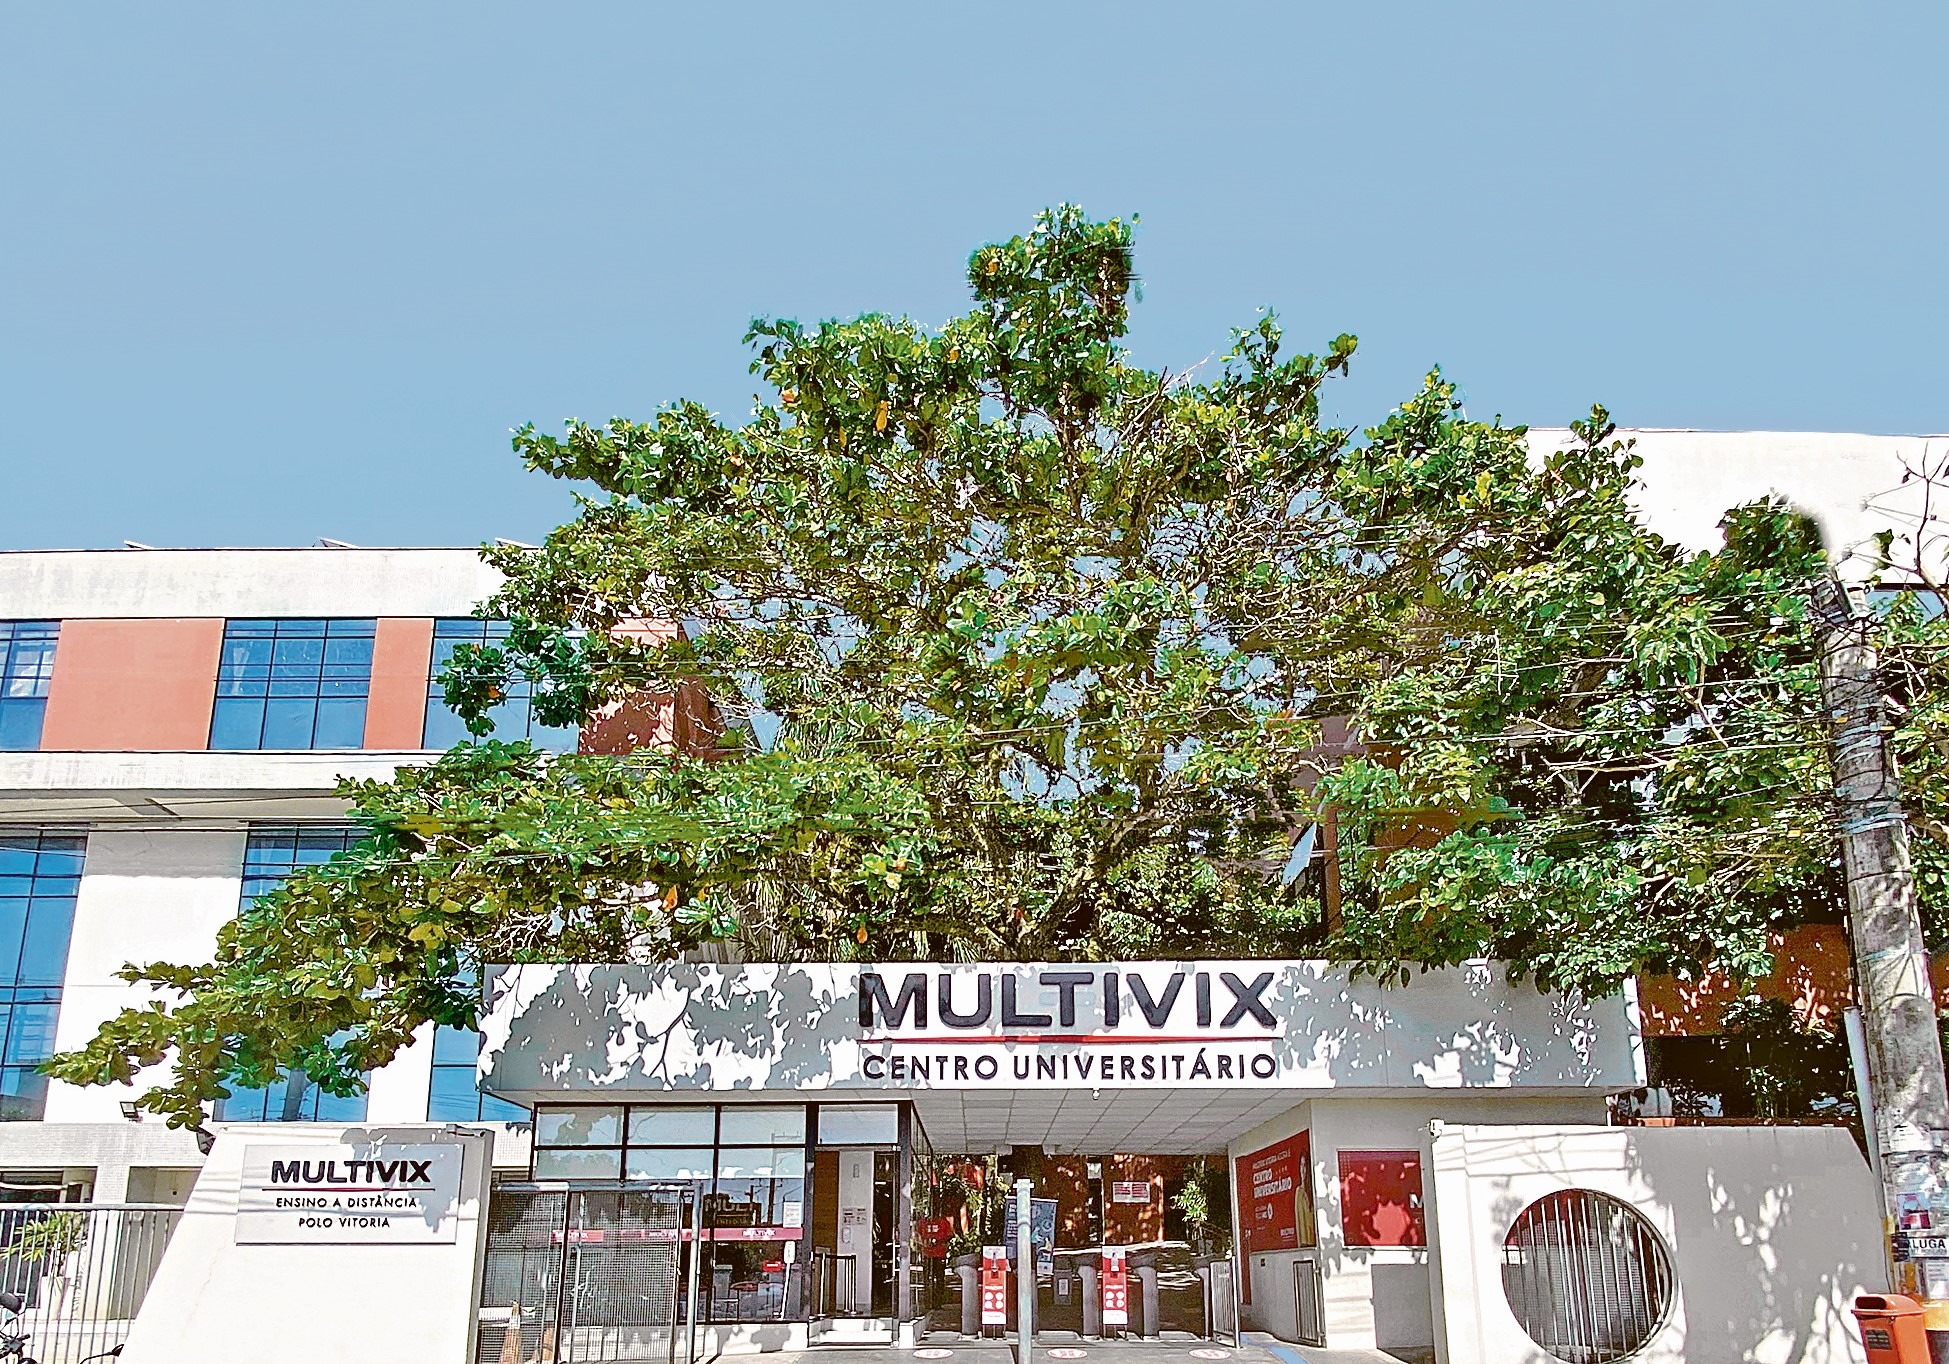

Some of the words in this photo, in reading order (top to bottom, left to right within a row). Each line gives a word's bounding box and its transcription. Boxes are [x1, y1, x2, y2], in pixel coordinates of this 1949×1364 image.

[858, 972, 1277, 1029] MULTIVIX
[862, 1054, 998, 1080] CENTRO
[1013, 1047, 1277, 1080] UNIVERSITÁRIO
[271, 1160, 432, 1184] MULTIVIX
[275, 1197, 327, 1208] ENSINO
[333, 1197, 341, 1208] A
[299, 1217, 333, 1228] POLO
[339, 1217, 390, 1228] VITORIA
[1908, 1239, 1946, 1249] LUGA
